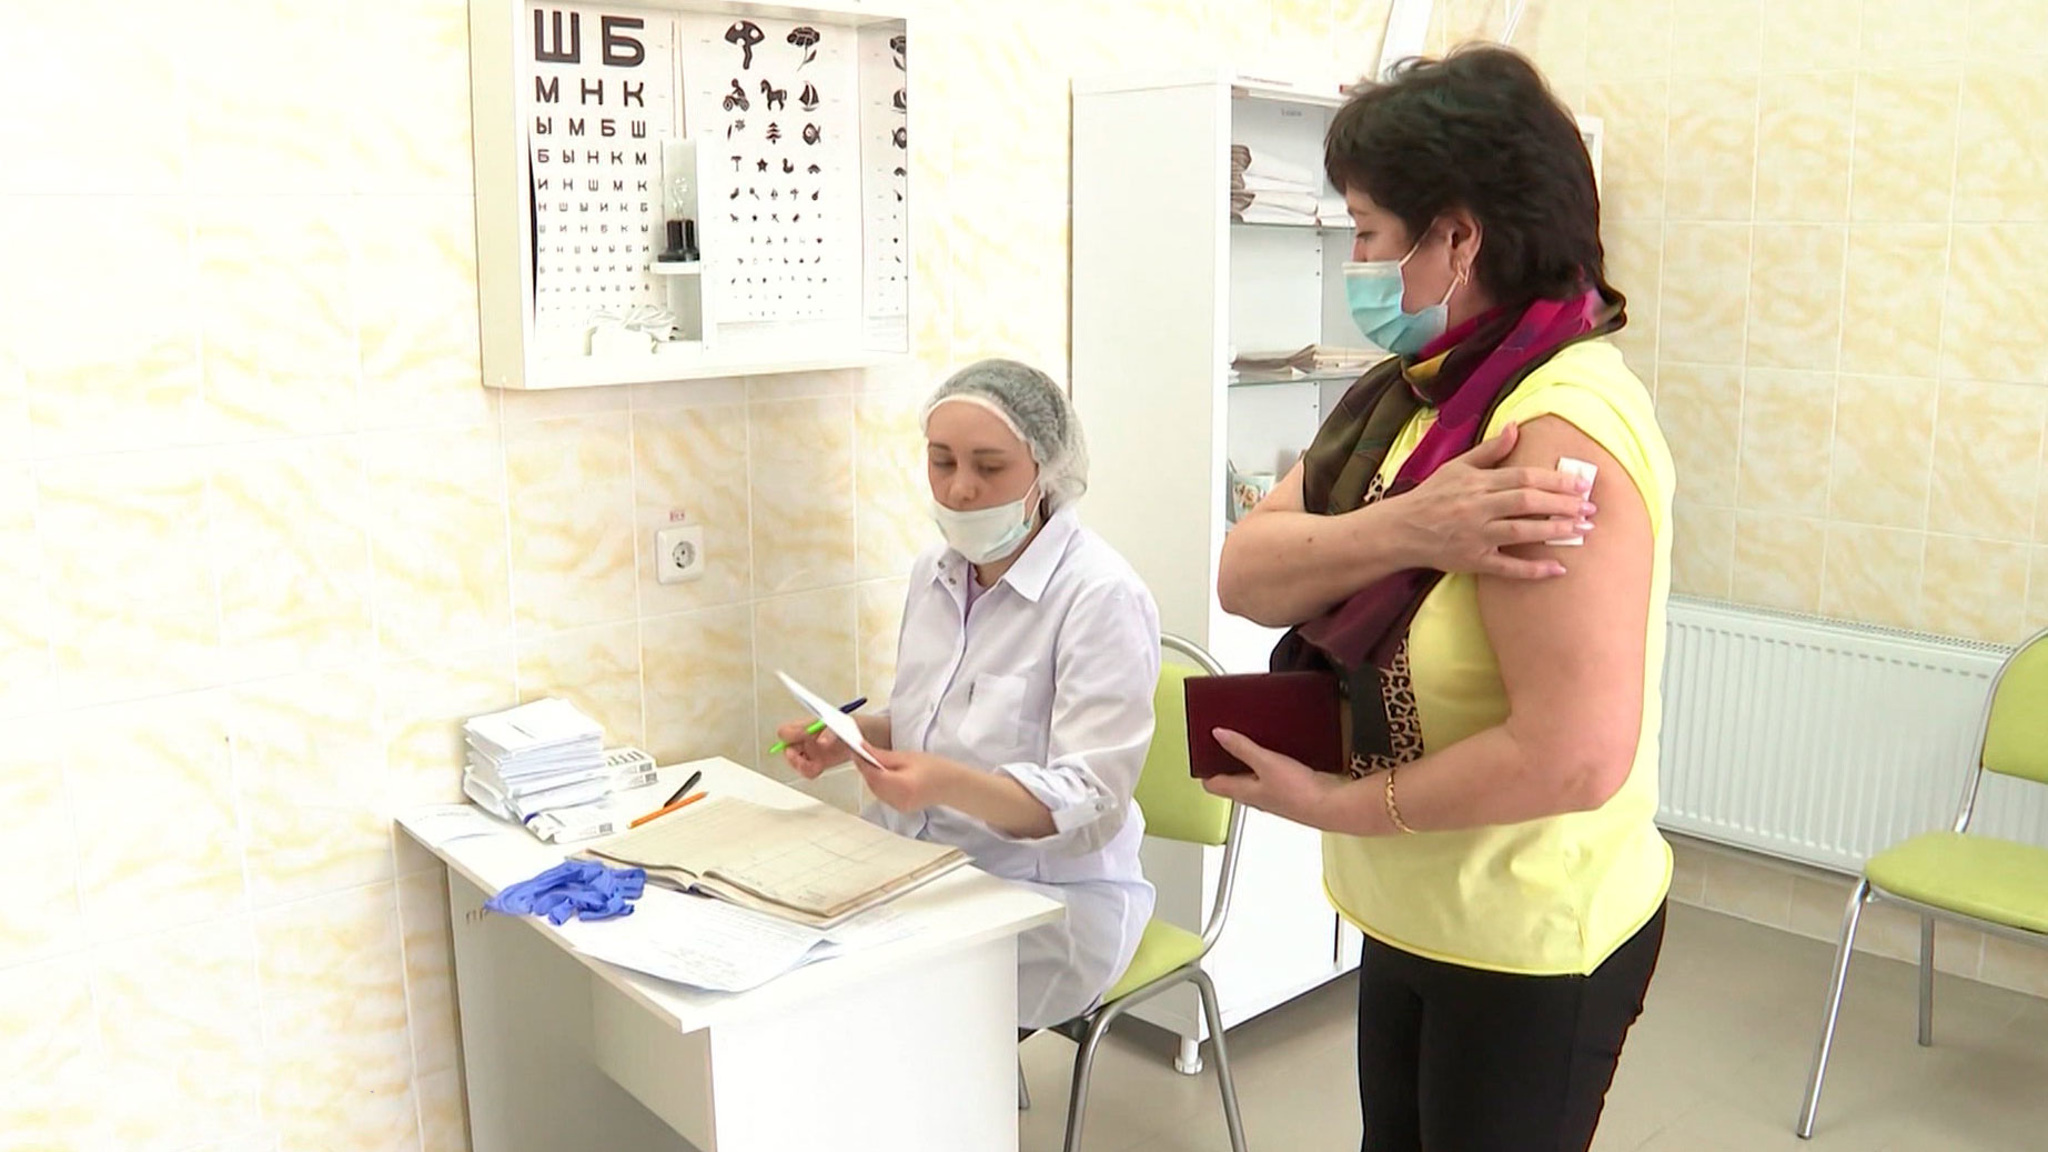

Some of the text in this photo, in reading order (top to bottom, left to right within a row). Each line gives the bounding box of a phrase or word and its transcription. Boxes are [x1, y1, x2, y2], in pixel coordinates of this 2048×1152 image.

[534, 9, 645, 67] Ш Б
[536, 76, 644, 107] М Н К
[536, 116, 646, 138] Ы М Б Ш
[538, 149, 646, 164] Б Ы Н К М
[537, 178, 648, 192] И Н Ш М К
